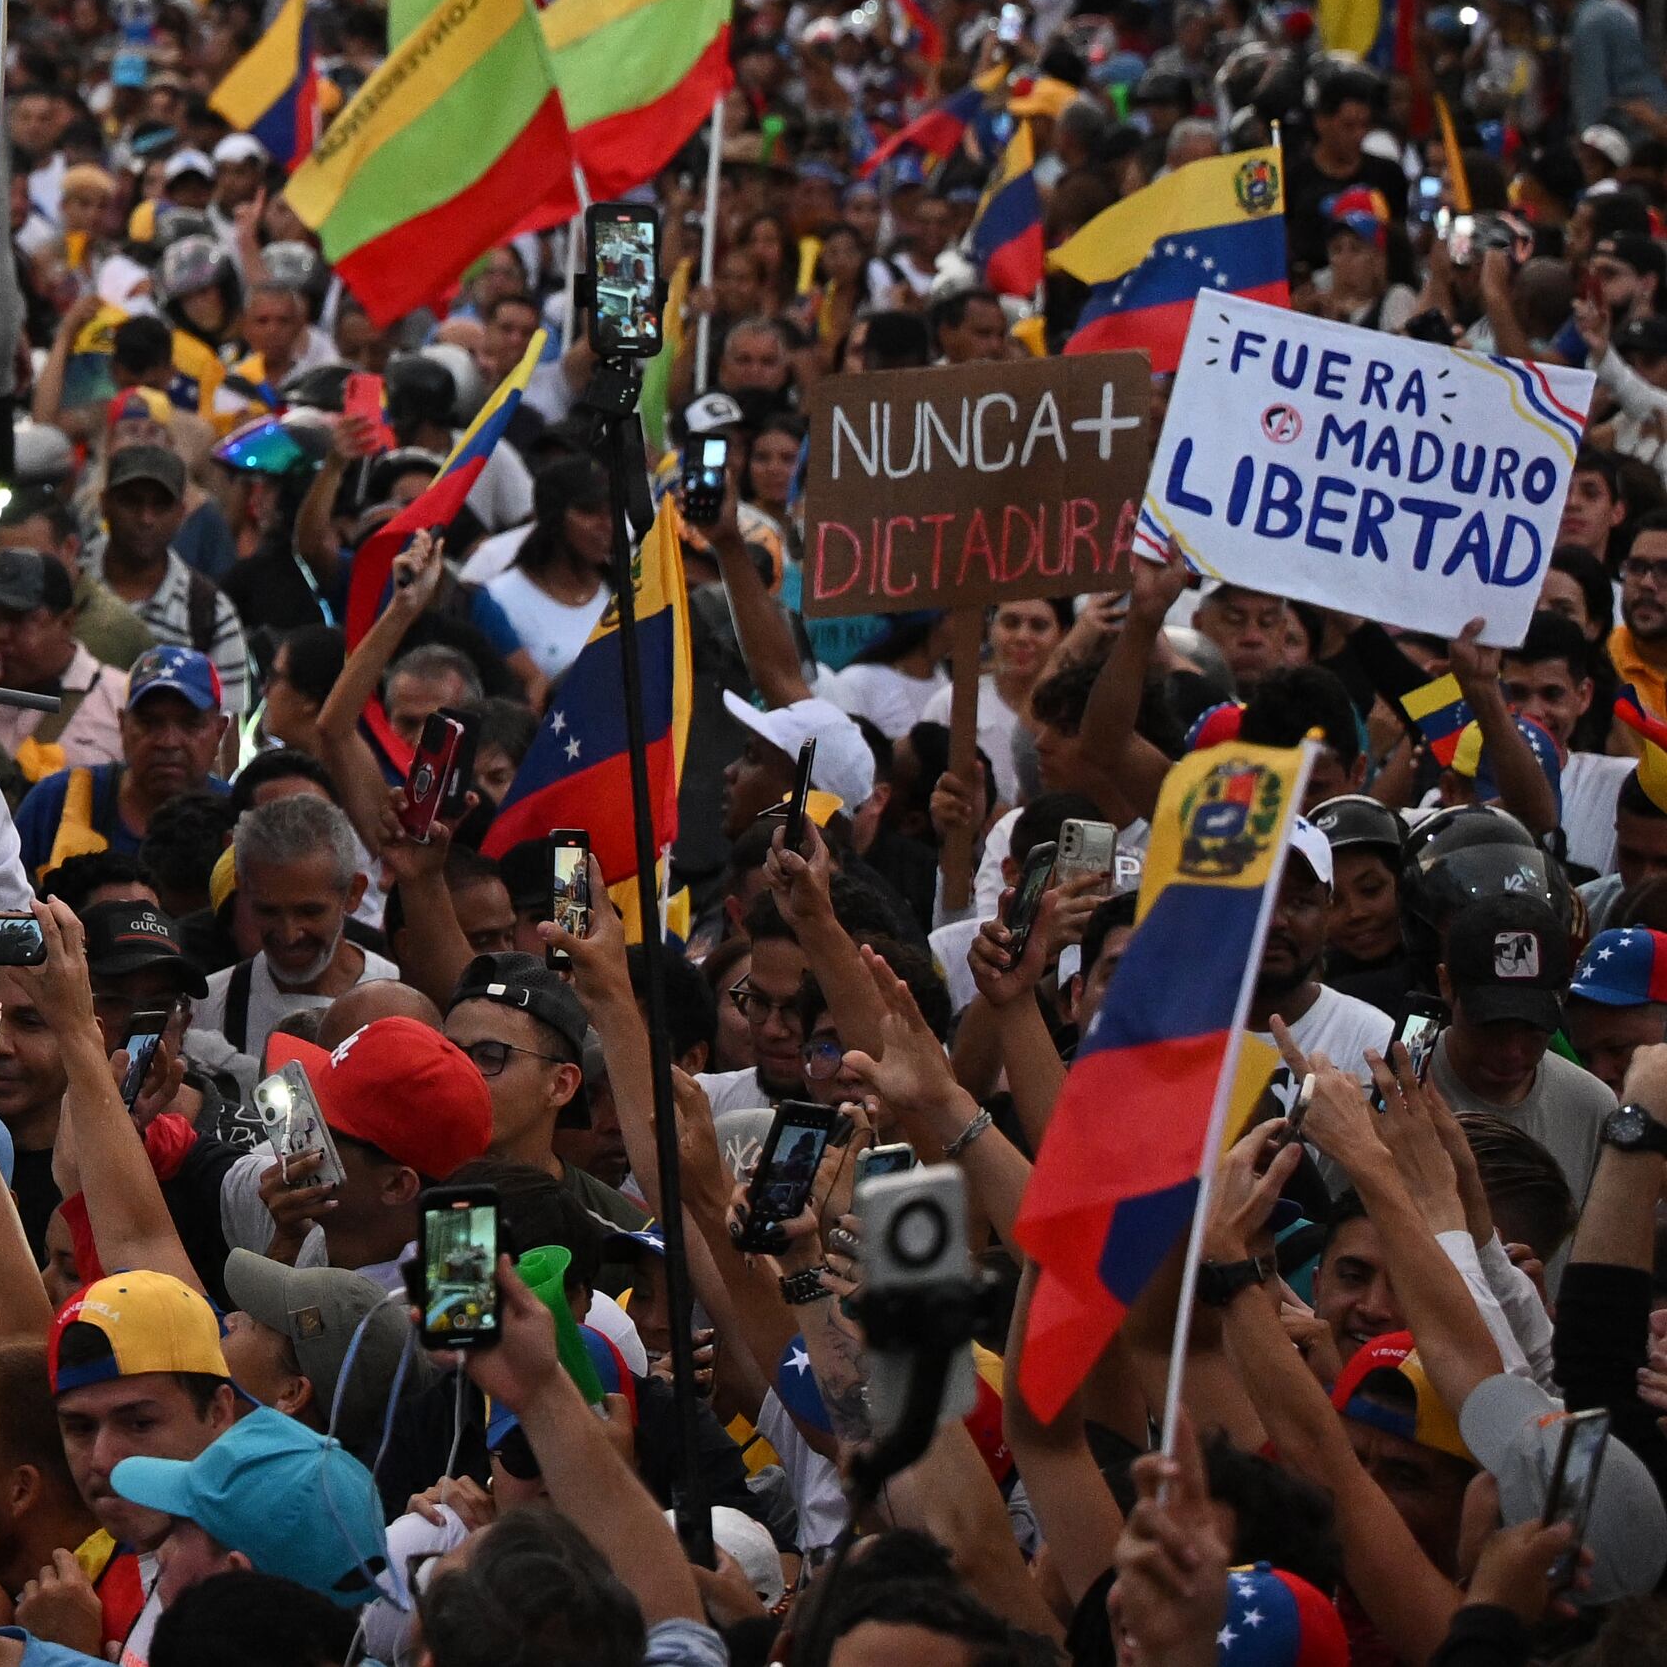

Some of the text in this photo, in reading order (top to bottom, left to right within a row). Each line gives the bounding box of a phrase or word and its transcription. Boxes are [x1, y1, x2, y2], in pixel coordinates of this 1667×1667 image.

[1230, 330, 1427, 417] FUERA
[1316, 413, 1557, 505] MADURO
[814, 498, 1138, 599] DICTADURA
[1165, 436, 1542, 587] LIBERTAD
[130, 920, 169, 936] GUCCI
